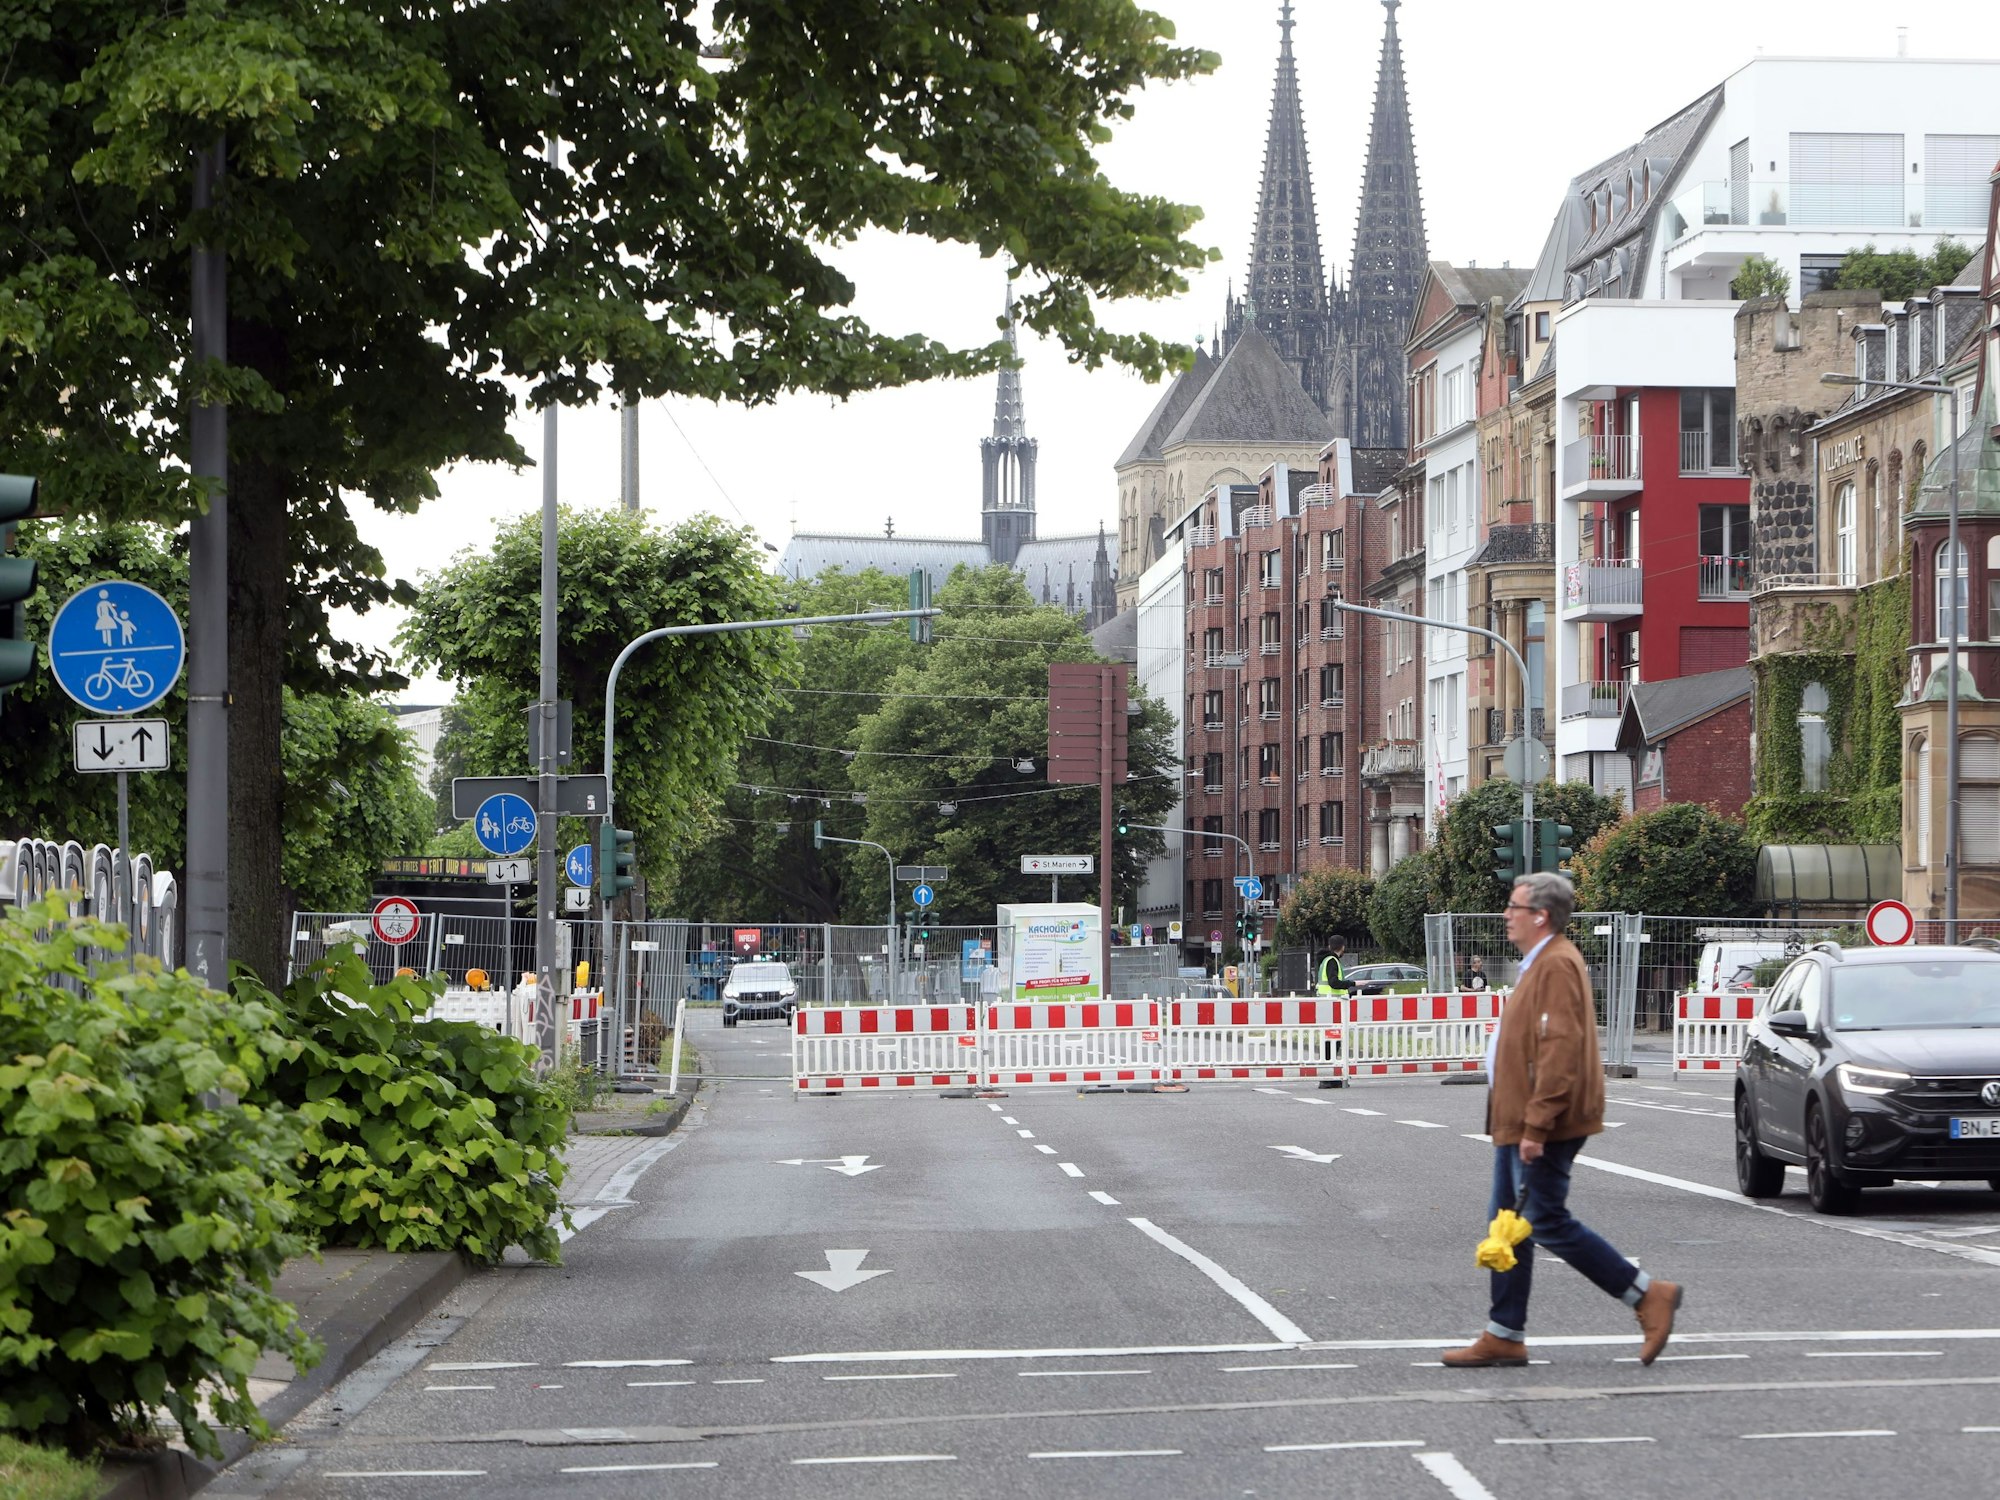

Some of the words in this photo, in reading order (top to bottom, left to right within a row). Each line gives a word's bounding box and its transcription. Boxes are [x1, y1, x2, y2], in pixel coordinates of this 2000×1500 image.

[1028, 925, 1069, 933] KACHOURI
[738, 934, 756, 942] INFIELD
[1961, 1121, 1980, 1135] BN
